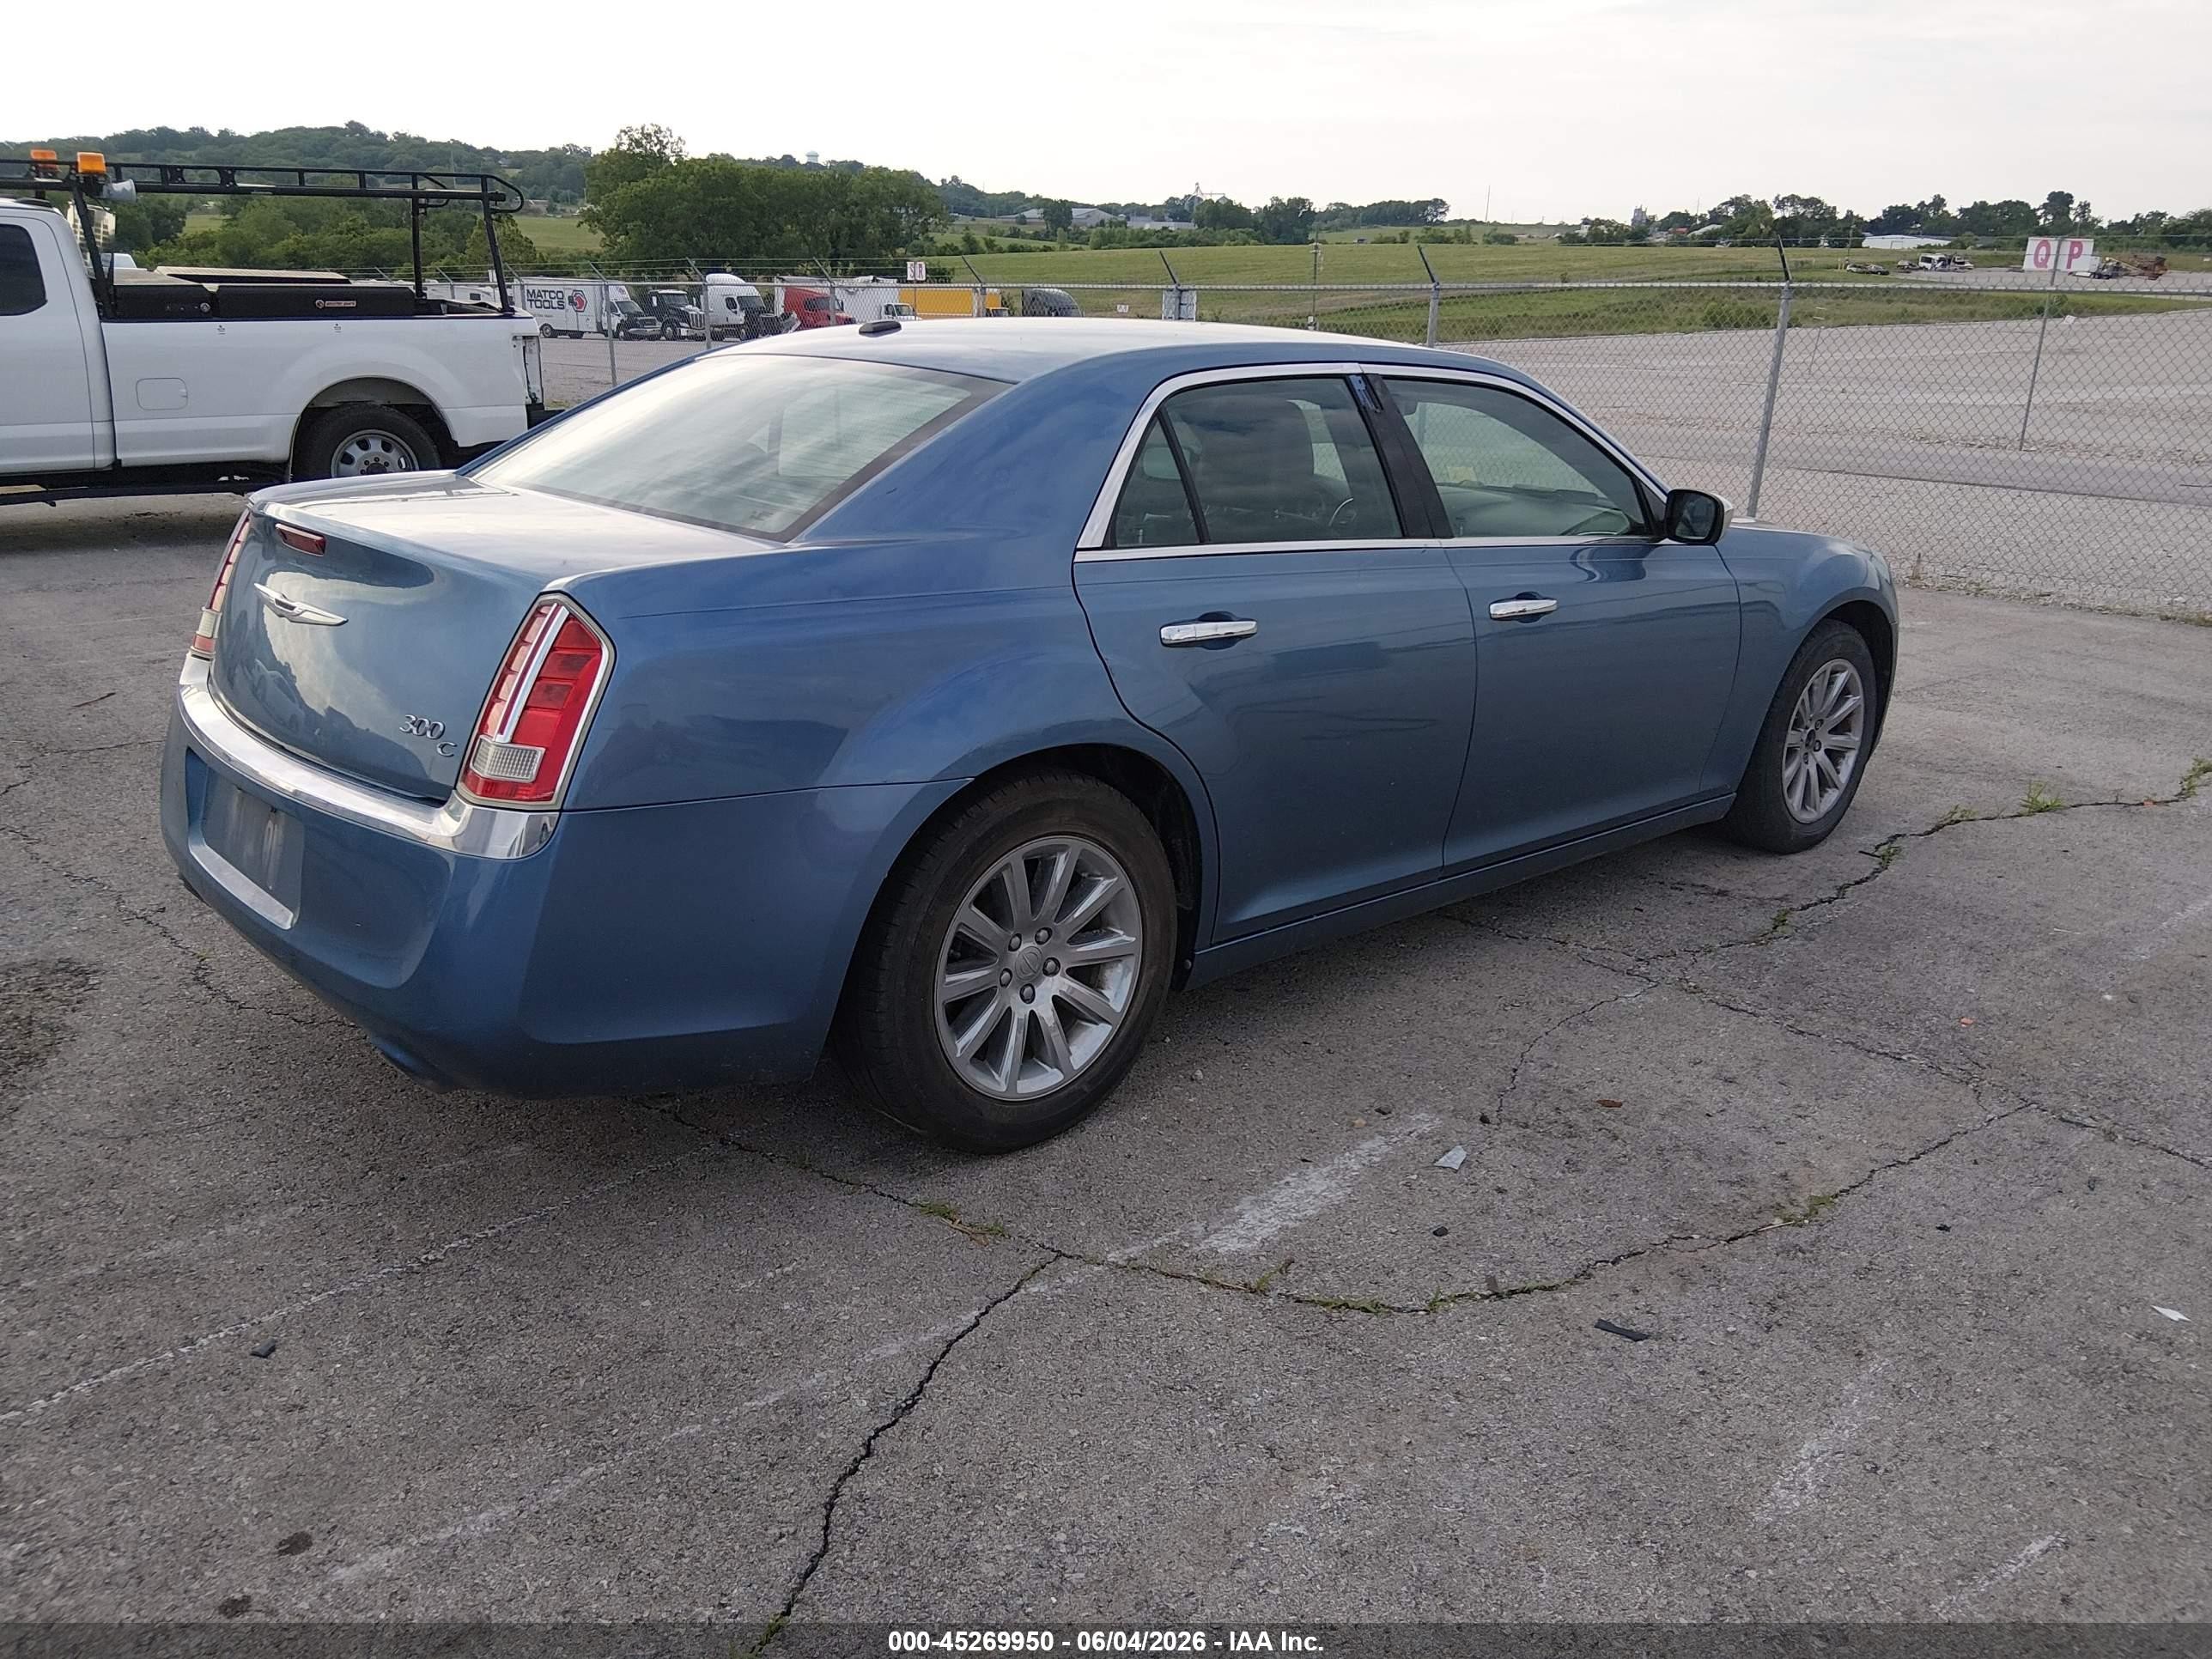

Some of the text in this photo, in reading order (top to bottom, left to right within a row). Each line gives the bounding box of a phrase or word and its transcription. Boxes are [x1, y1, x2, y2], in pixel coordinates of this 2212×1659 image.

[2033, 240, 2083, 270] Q P
[526, 289, 564, 300] MATCO
[527, 299, 565, 310] TOOLS
[399, 714, 446, 740] 300
